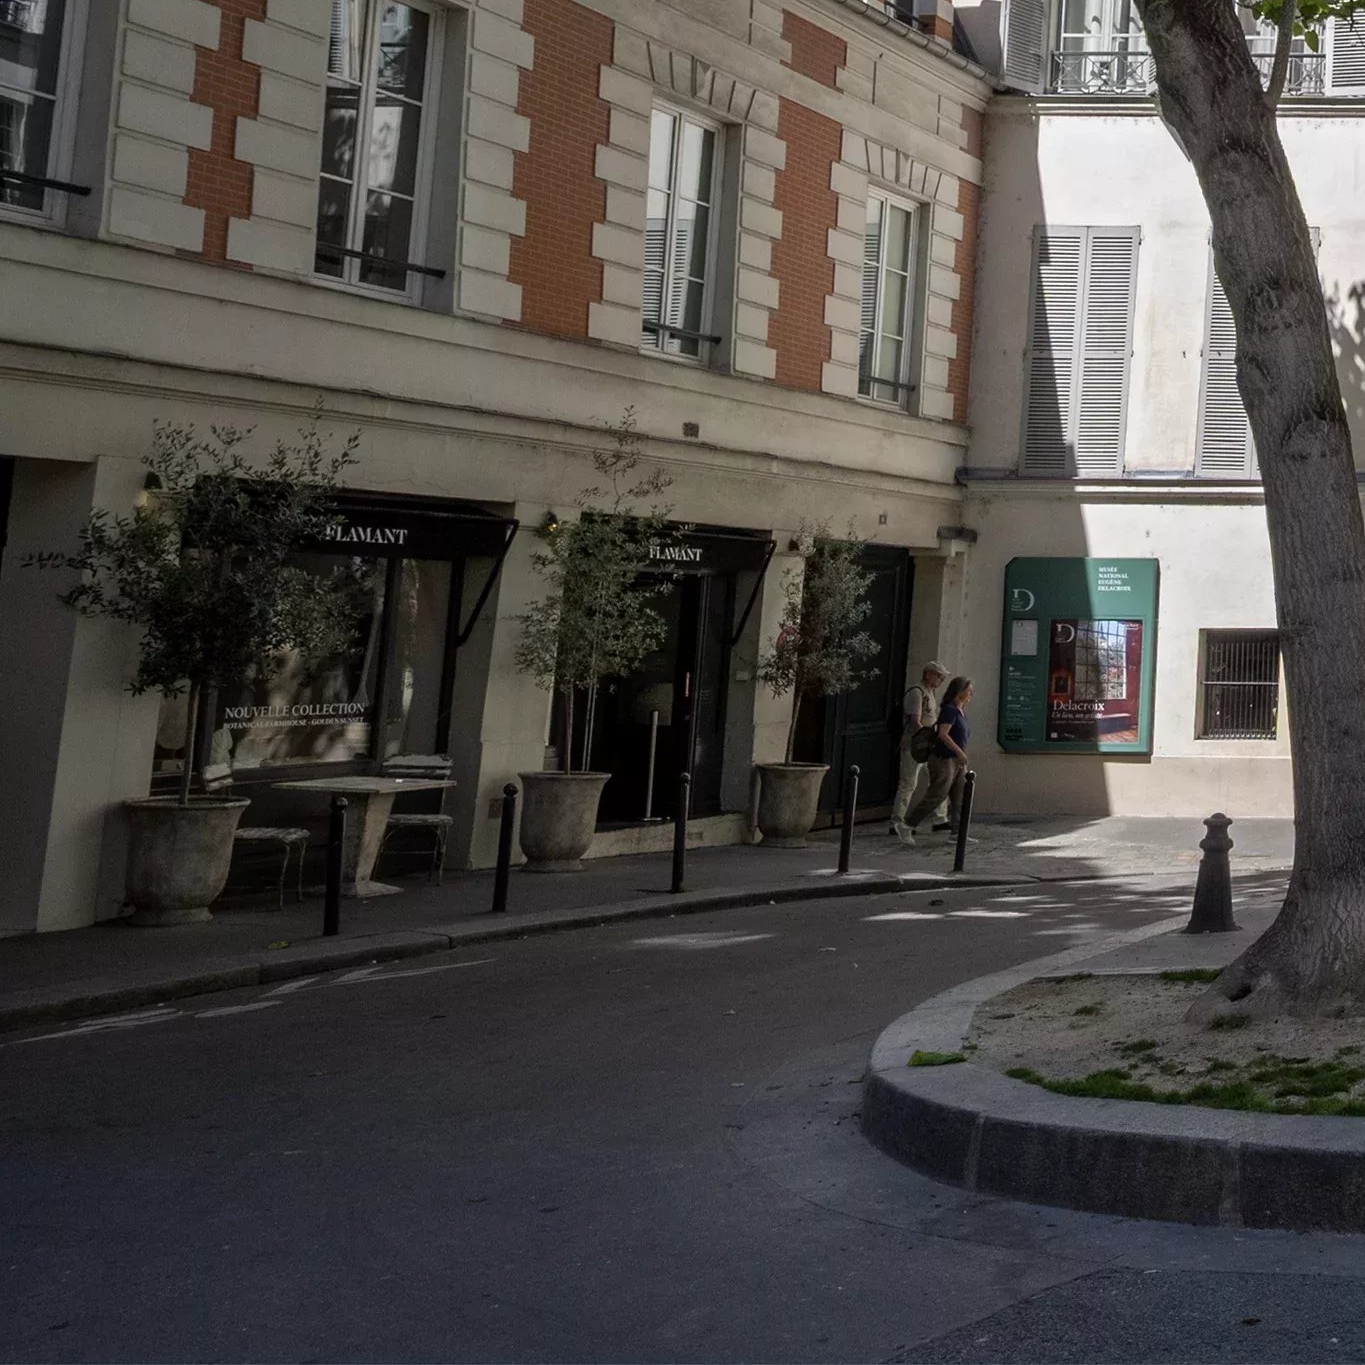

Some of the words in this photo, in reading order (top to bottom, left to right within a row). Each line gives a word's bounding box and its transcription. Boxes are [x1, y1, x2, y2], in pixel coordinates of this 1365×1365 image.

[325, 524, 409, 545] FLAMANT
[649, 545, 703, 562] FLAMANT
[224, 705, 289, 719] NOUVELLE
[291, 702, 365, 717] COLLECTION
[1053, 699, 1105, 711] Delacroix
[222, 720, 263, 730] BOTANICAL
[311, 717, 340, 726] GOLDEN
